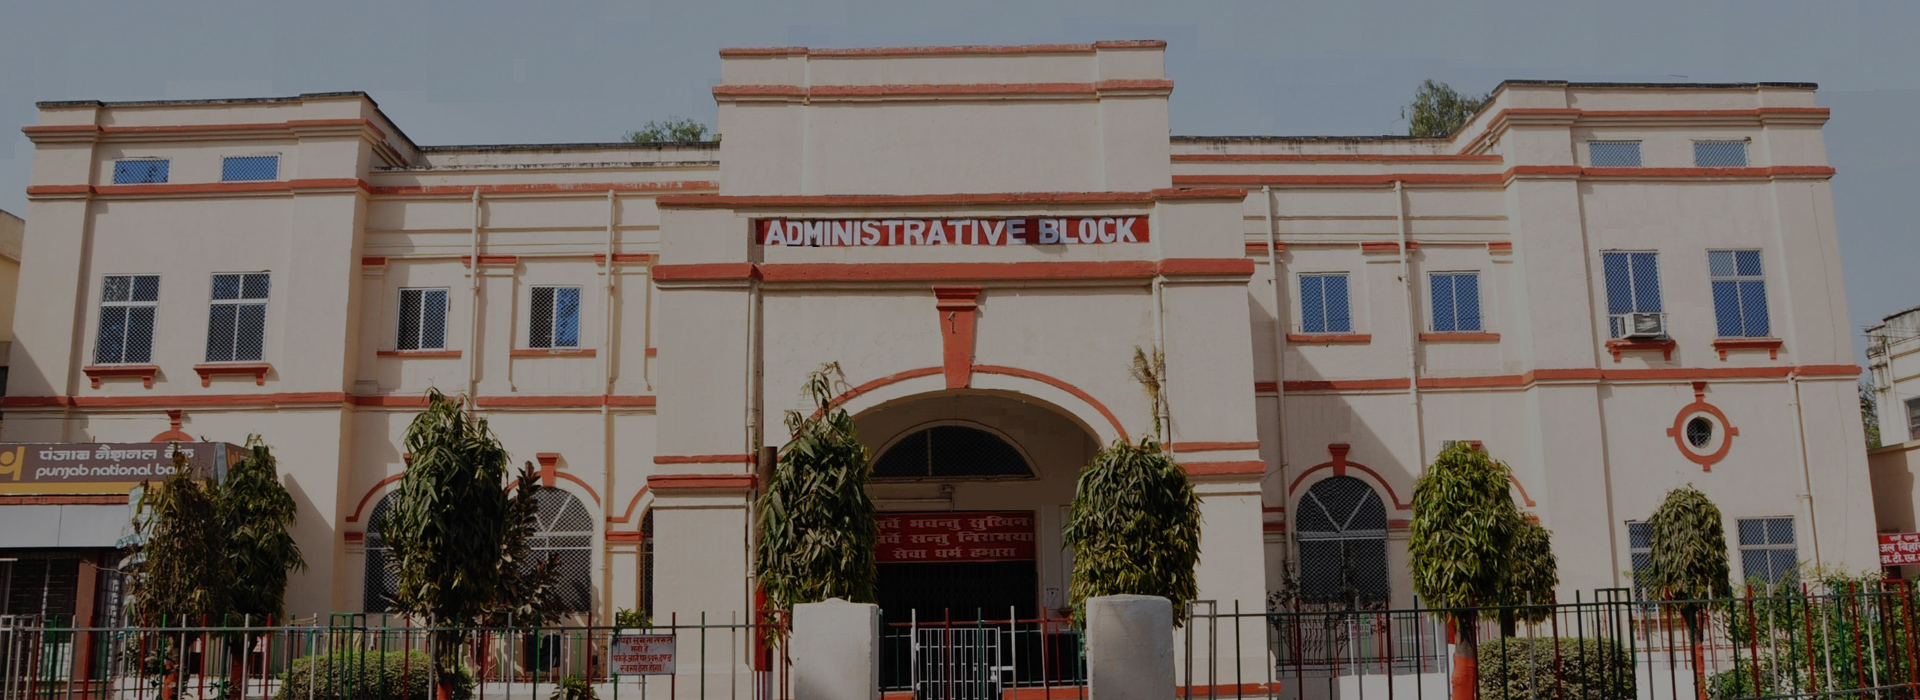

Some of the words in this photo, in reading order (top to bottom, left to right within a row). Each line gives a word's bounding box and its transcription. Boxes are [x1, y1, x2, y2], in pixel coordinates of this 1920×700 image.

[765, 218, 1026, 246] ADMINISTRATIVE
[1039, 217, 1137, 245] BLOCK
[39, 447, 91, 461] पंजाब
[95, 444, 157, 462] नैशनल
[35, 464, 89, 480] punjab
[91, 463, 153, 477] national
[892, 547, 928, 559] सेवा
[934, 546, 963, 558] धर्म
